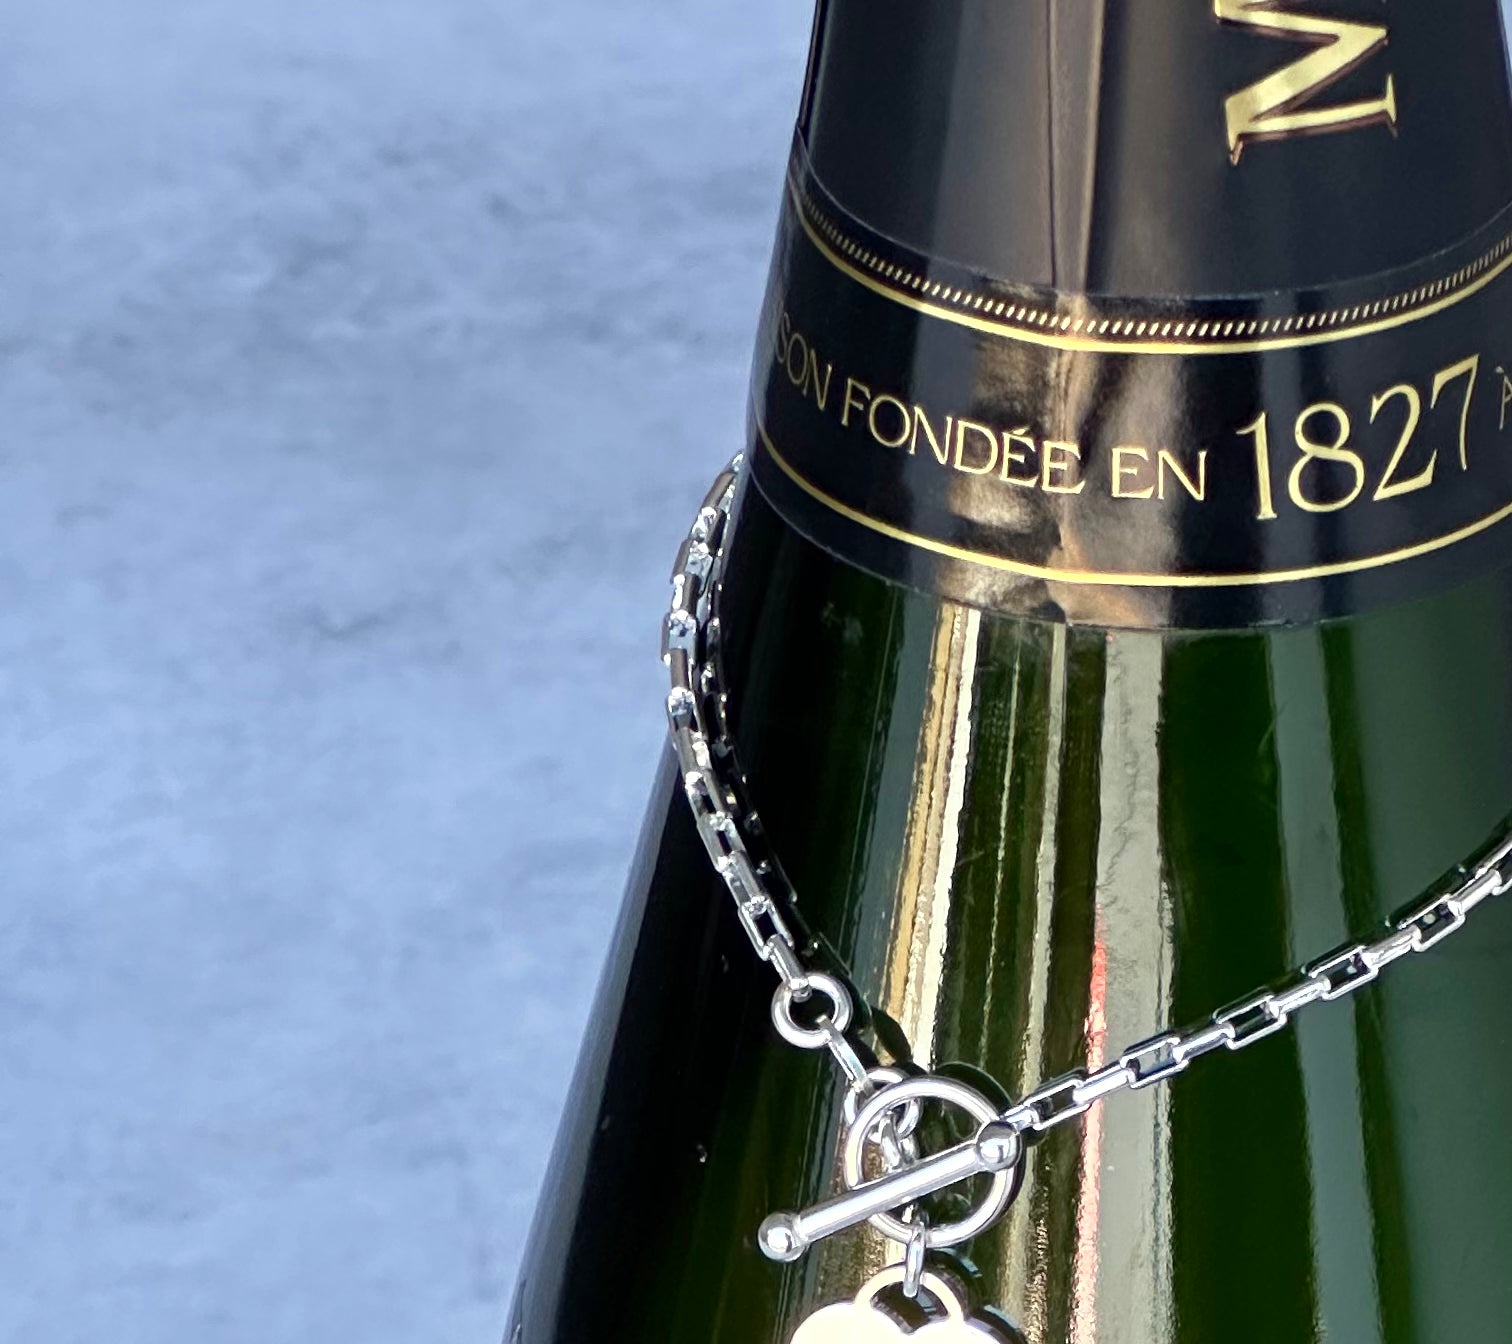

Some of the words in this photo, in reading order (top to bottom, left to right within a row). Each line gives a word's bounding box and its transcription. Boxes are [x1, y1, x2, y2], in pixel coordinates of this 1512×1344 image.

[841, 376, 1086, 496] FONDÉE
[1110, 446, 1207, 502] EN
[1235, 353, 1480, 521] 1827
